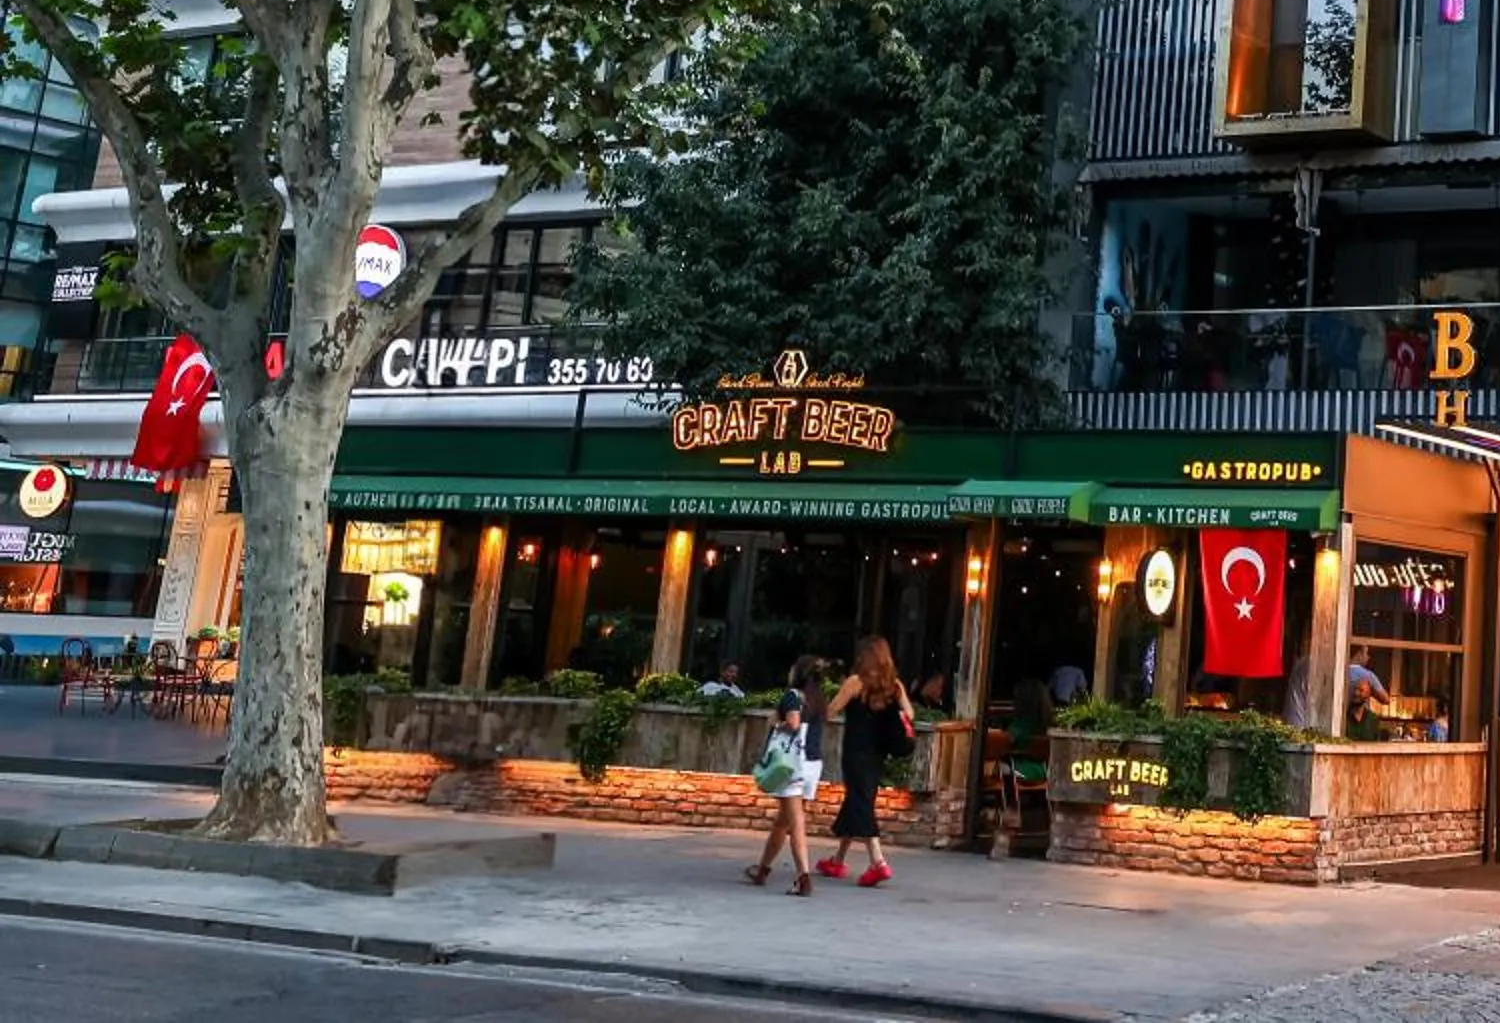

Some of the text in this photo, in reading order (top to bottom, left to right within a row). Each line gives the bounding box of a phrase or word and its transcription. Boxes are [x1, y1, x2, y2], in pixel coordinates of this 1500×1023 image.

[547, 358, 588, 384] 355
[673, 398, 896, 452] CRAFT BEER
[759, 450, 802, 474] LAB
[1190, 462, 1313, 481] GASTROPUB
[585, 496, 649, 513] ORIGINAL
[670, 498, 715, 515] LOCAL
[730, 498, 855, 518] AWARD-WINNING
[861, 503, 950, 520] GASTROPU
[1108, 506, 1231, 525] BAR KITCHEN
[1071, 758, 1169, 787] CRAFT BEER
